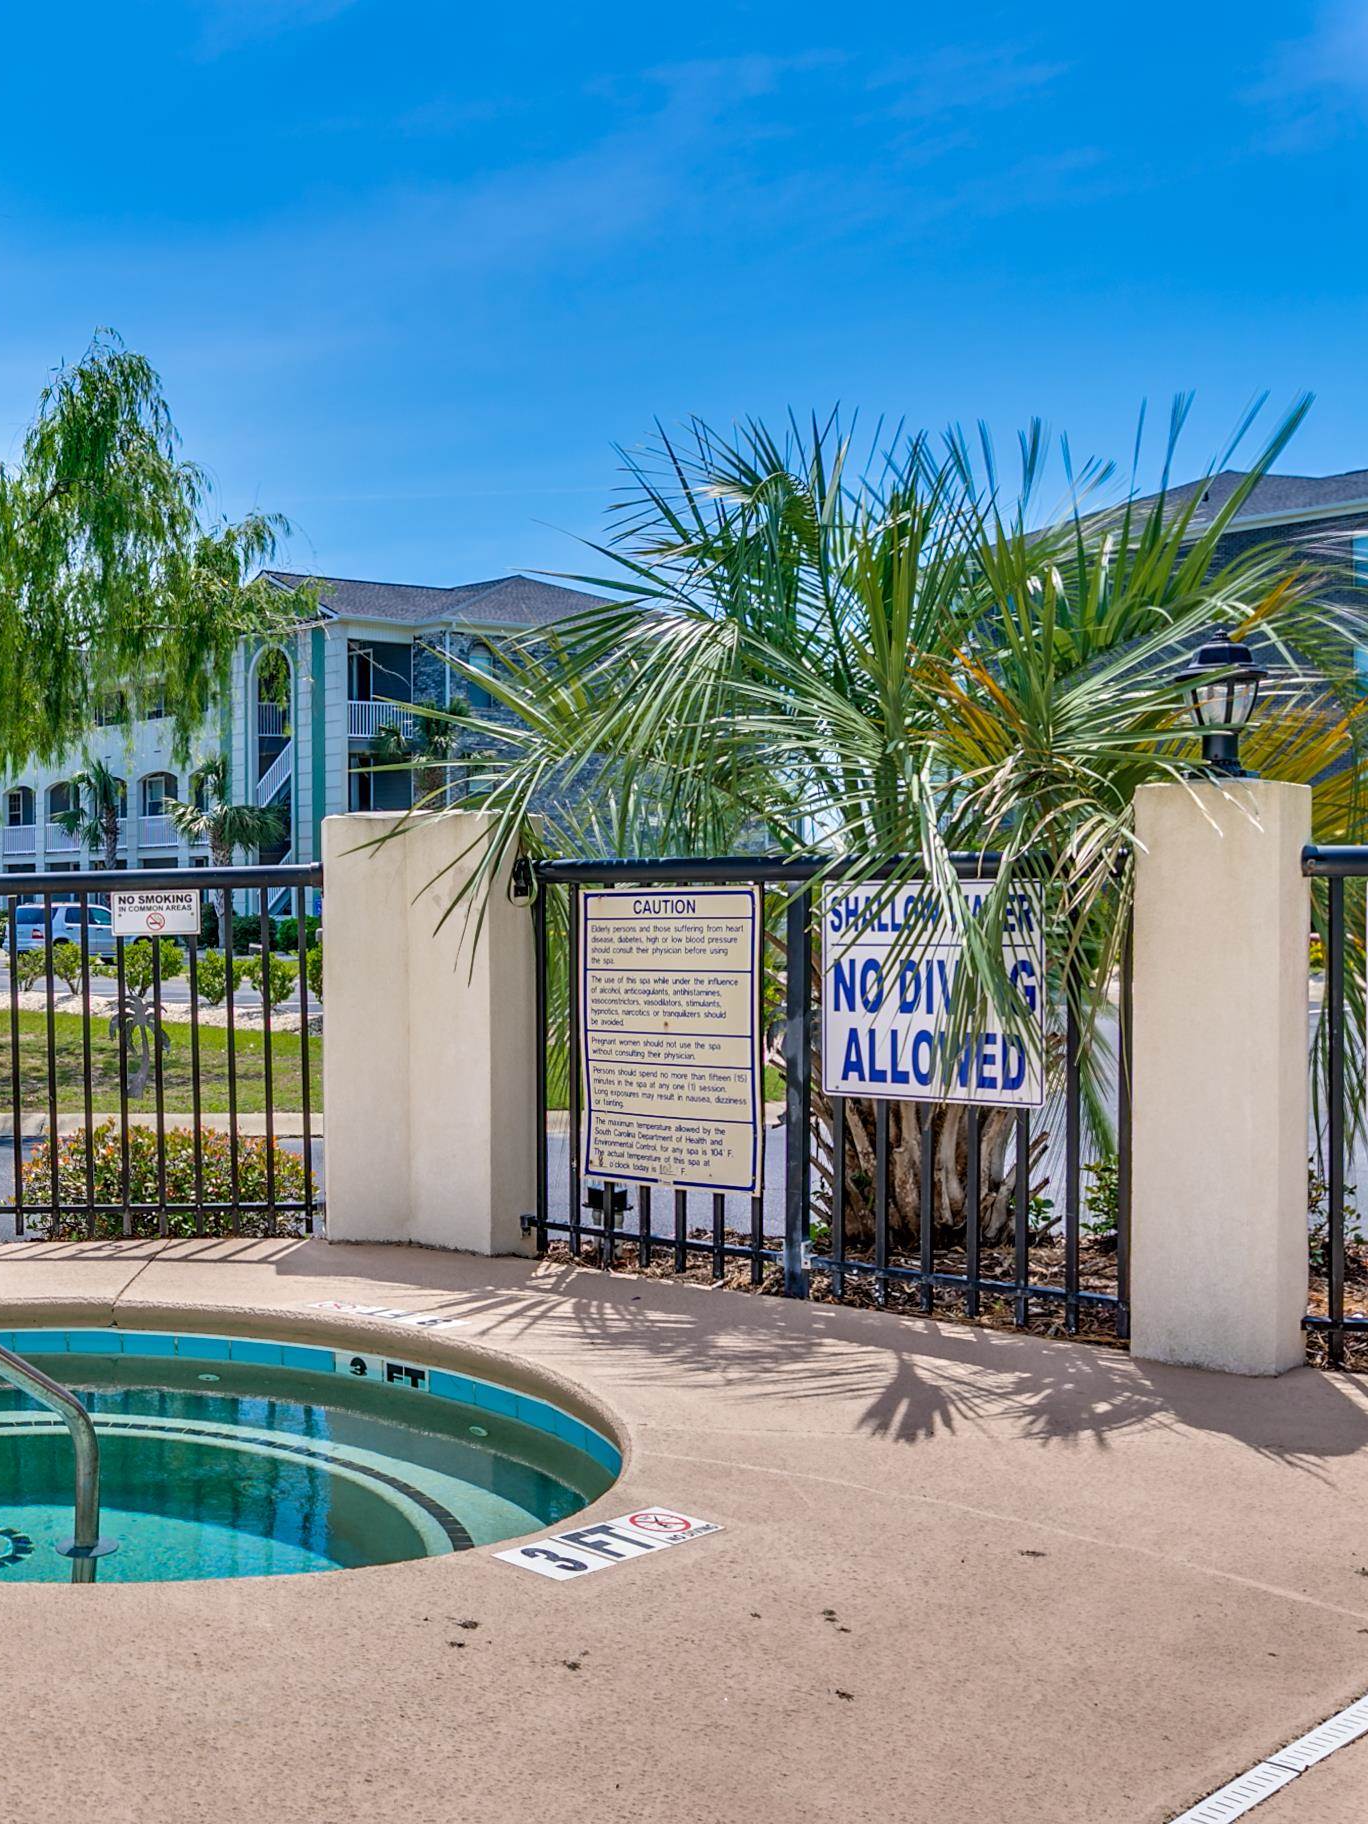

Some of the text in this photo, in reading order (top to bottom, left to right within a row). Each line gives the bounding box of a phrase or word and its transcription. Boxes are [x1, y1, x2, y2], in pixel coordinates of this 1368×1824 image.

[118, 894, 193, 905] NO SMOKING
[633, 900, 696, 914] CAUTION
[830, 896, 937, 932] SHALLOW
[591, 925, 611, 933] Elderly
[613, 925, 636, 933] persons
[674, 925, 703, 934] suffering
[646, 936, 659, 944] high
[652, 947, 682, 955] physician
[617, 976, 624, 984] of
[708, 978, 738, 986] influence
[833, 958, 1036, 1017] NO DIVG
[622, 1009, 650, 1017] narcotics
[662, 1010, 700, 1019] tranquilizers
[704, 1011, 726, 1019] should
[592, 1037, 616, 1047] Pregnant
[619, 1039, 640, 1047] women
[643, 1039, 663, 1048] should
[666, 1040, 676, 1048] not
[694, 1041, 705, 1049] the
[709, 1042, 721, 1050] spa
[615, 1049, 645, 1059] consulting
[664, 1052, 696, 1060] physician.
[593, 1066, 615, 1075] Persons
[618, 1068, 636, 1076] should
[639, 1069, 657, 1078] spend
[671, 1072, 688, 1080] more
[691, 1072, 705, 1080] than
[708, 1073, 731, 1082] fifteen
[734, 1074, 747, 1082] (15)
[594, 1078, 615, 1086] minutes
[624, 1079, 633, 1087] the
[659, 1083, 670, 1091] any
[688, 1083, 696, 1091] (1)
[595, 1088, 609, 1096] Long
[610, 1090, 639, 1098] exposures
[642, 1092, 654, 1100] may
[656, 1092, 675, 1100] result
[714, 1095, 747, 1104] dizziness
[595, 1117, 726, 1135] The maximum temperature allowed by the
[595, 1127, 723, 1146] South Carolina Department of Health and
[594, 1138, 633, 1148] Environmental
[671, 1146, 683, 1155] any
[686, 1148, 699, 1156] spa
[702, 1148, 707, 1156] is
[594, 1148, 604, 1156] The
[607, 1150, 625, 1158] actual
[626, 1151, 661, 1163] temperature
[664, 1155, 671, 1163] of
[673, 1156, 685, 1164] this
[688, 1158, 700, 1166] spa
[632, 1162, 649, 1172] today
[349, 1357, 426, 1389] 3 FT
[521, 1524, 656, 1572] 3 FT
